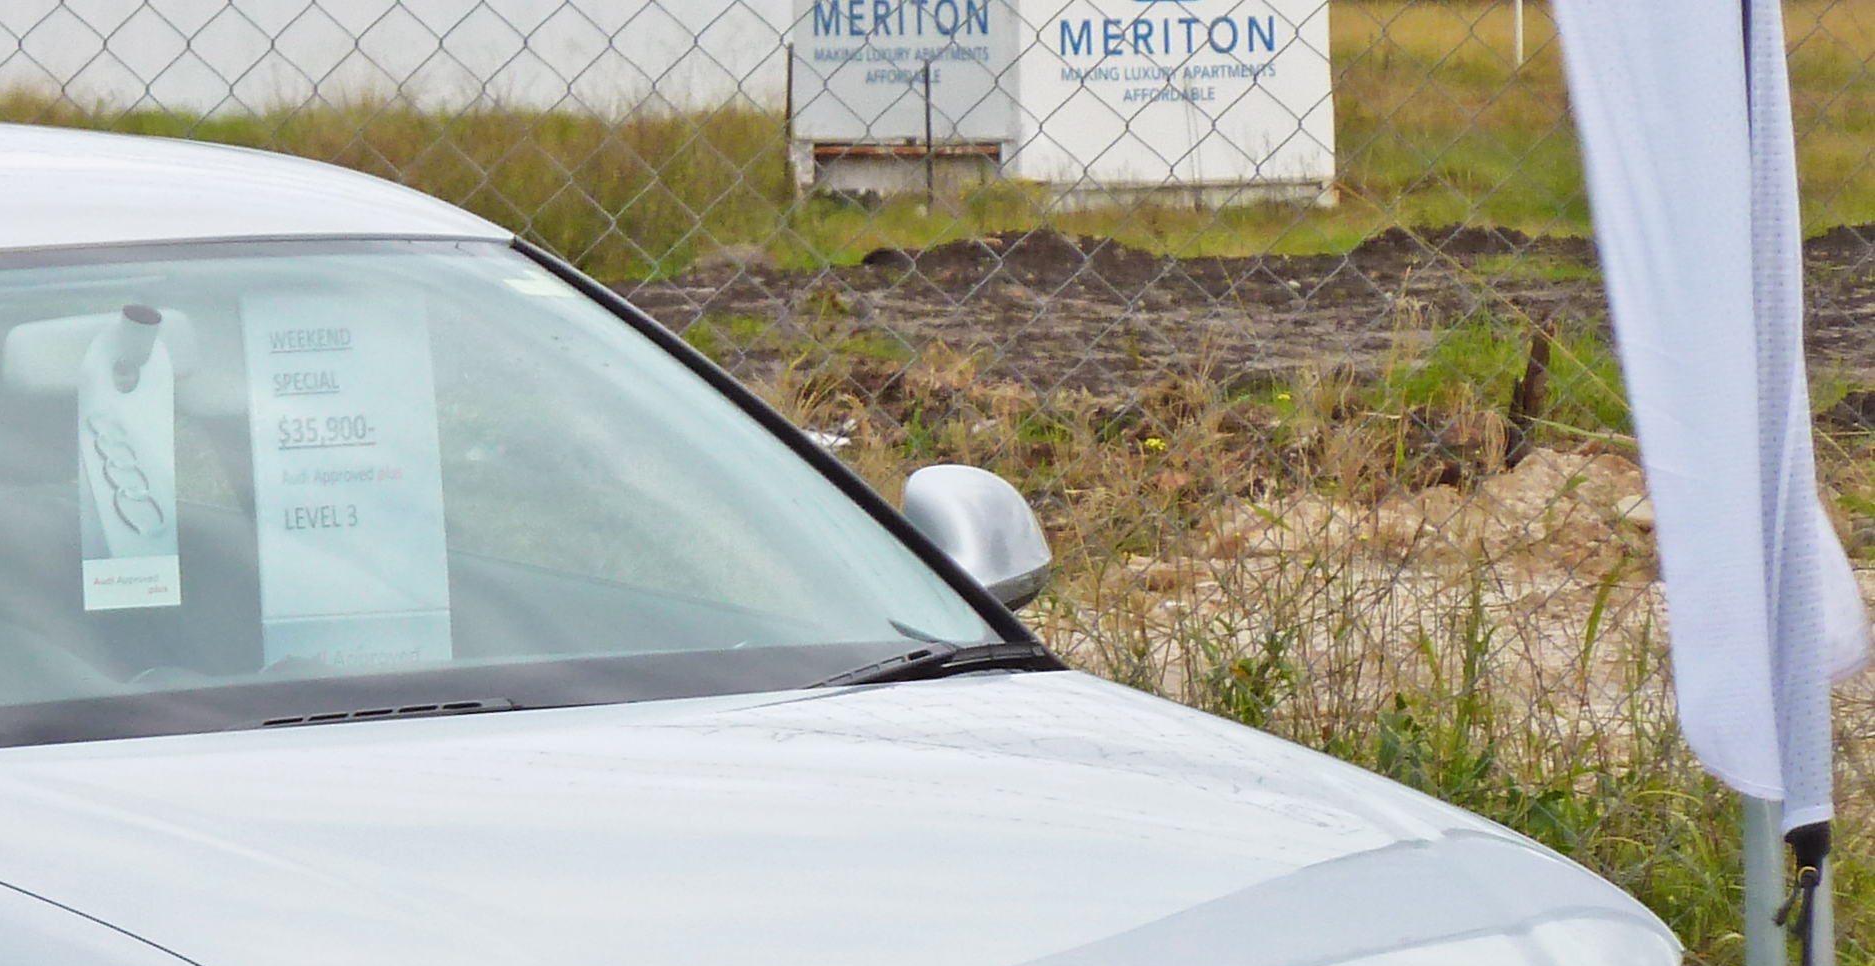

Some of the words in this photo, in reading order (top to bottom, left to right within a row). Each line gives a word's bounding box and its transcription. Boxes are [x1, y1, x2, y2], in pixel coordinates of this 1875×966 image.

[813, 0, 990, 36] MERITON
[1060, 15, 1276, 56] MERITON
[814, 47, 863, 62] MAKING
[866, 47, 911, 61] LUXURY
[915, 46, 990, 61] APARTMENTS
[1061, 67, 1120, 82] MAKING
[1124, 66, 1178, 81] LUXURY
[1183, 63, 1277, 80] APARTMENTS
[1123, 87, 1216, 103] AFFORDABLE
[269, 328, 352, 350] WEEKEND
[273, 371, 340, 392] SPECIAL
[282, 468, 308, 485] Audi
[313, 466, 374, 486] Approved
[377, 465, 403, 483] plus
[285, 507, 341, 531] LEVEL
[347, 504, 359, 528] 3
